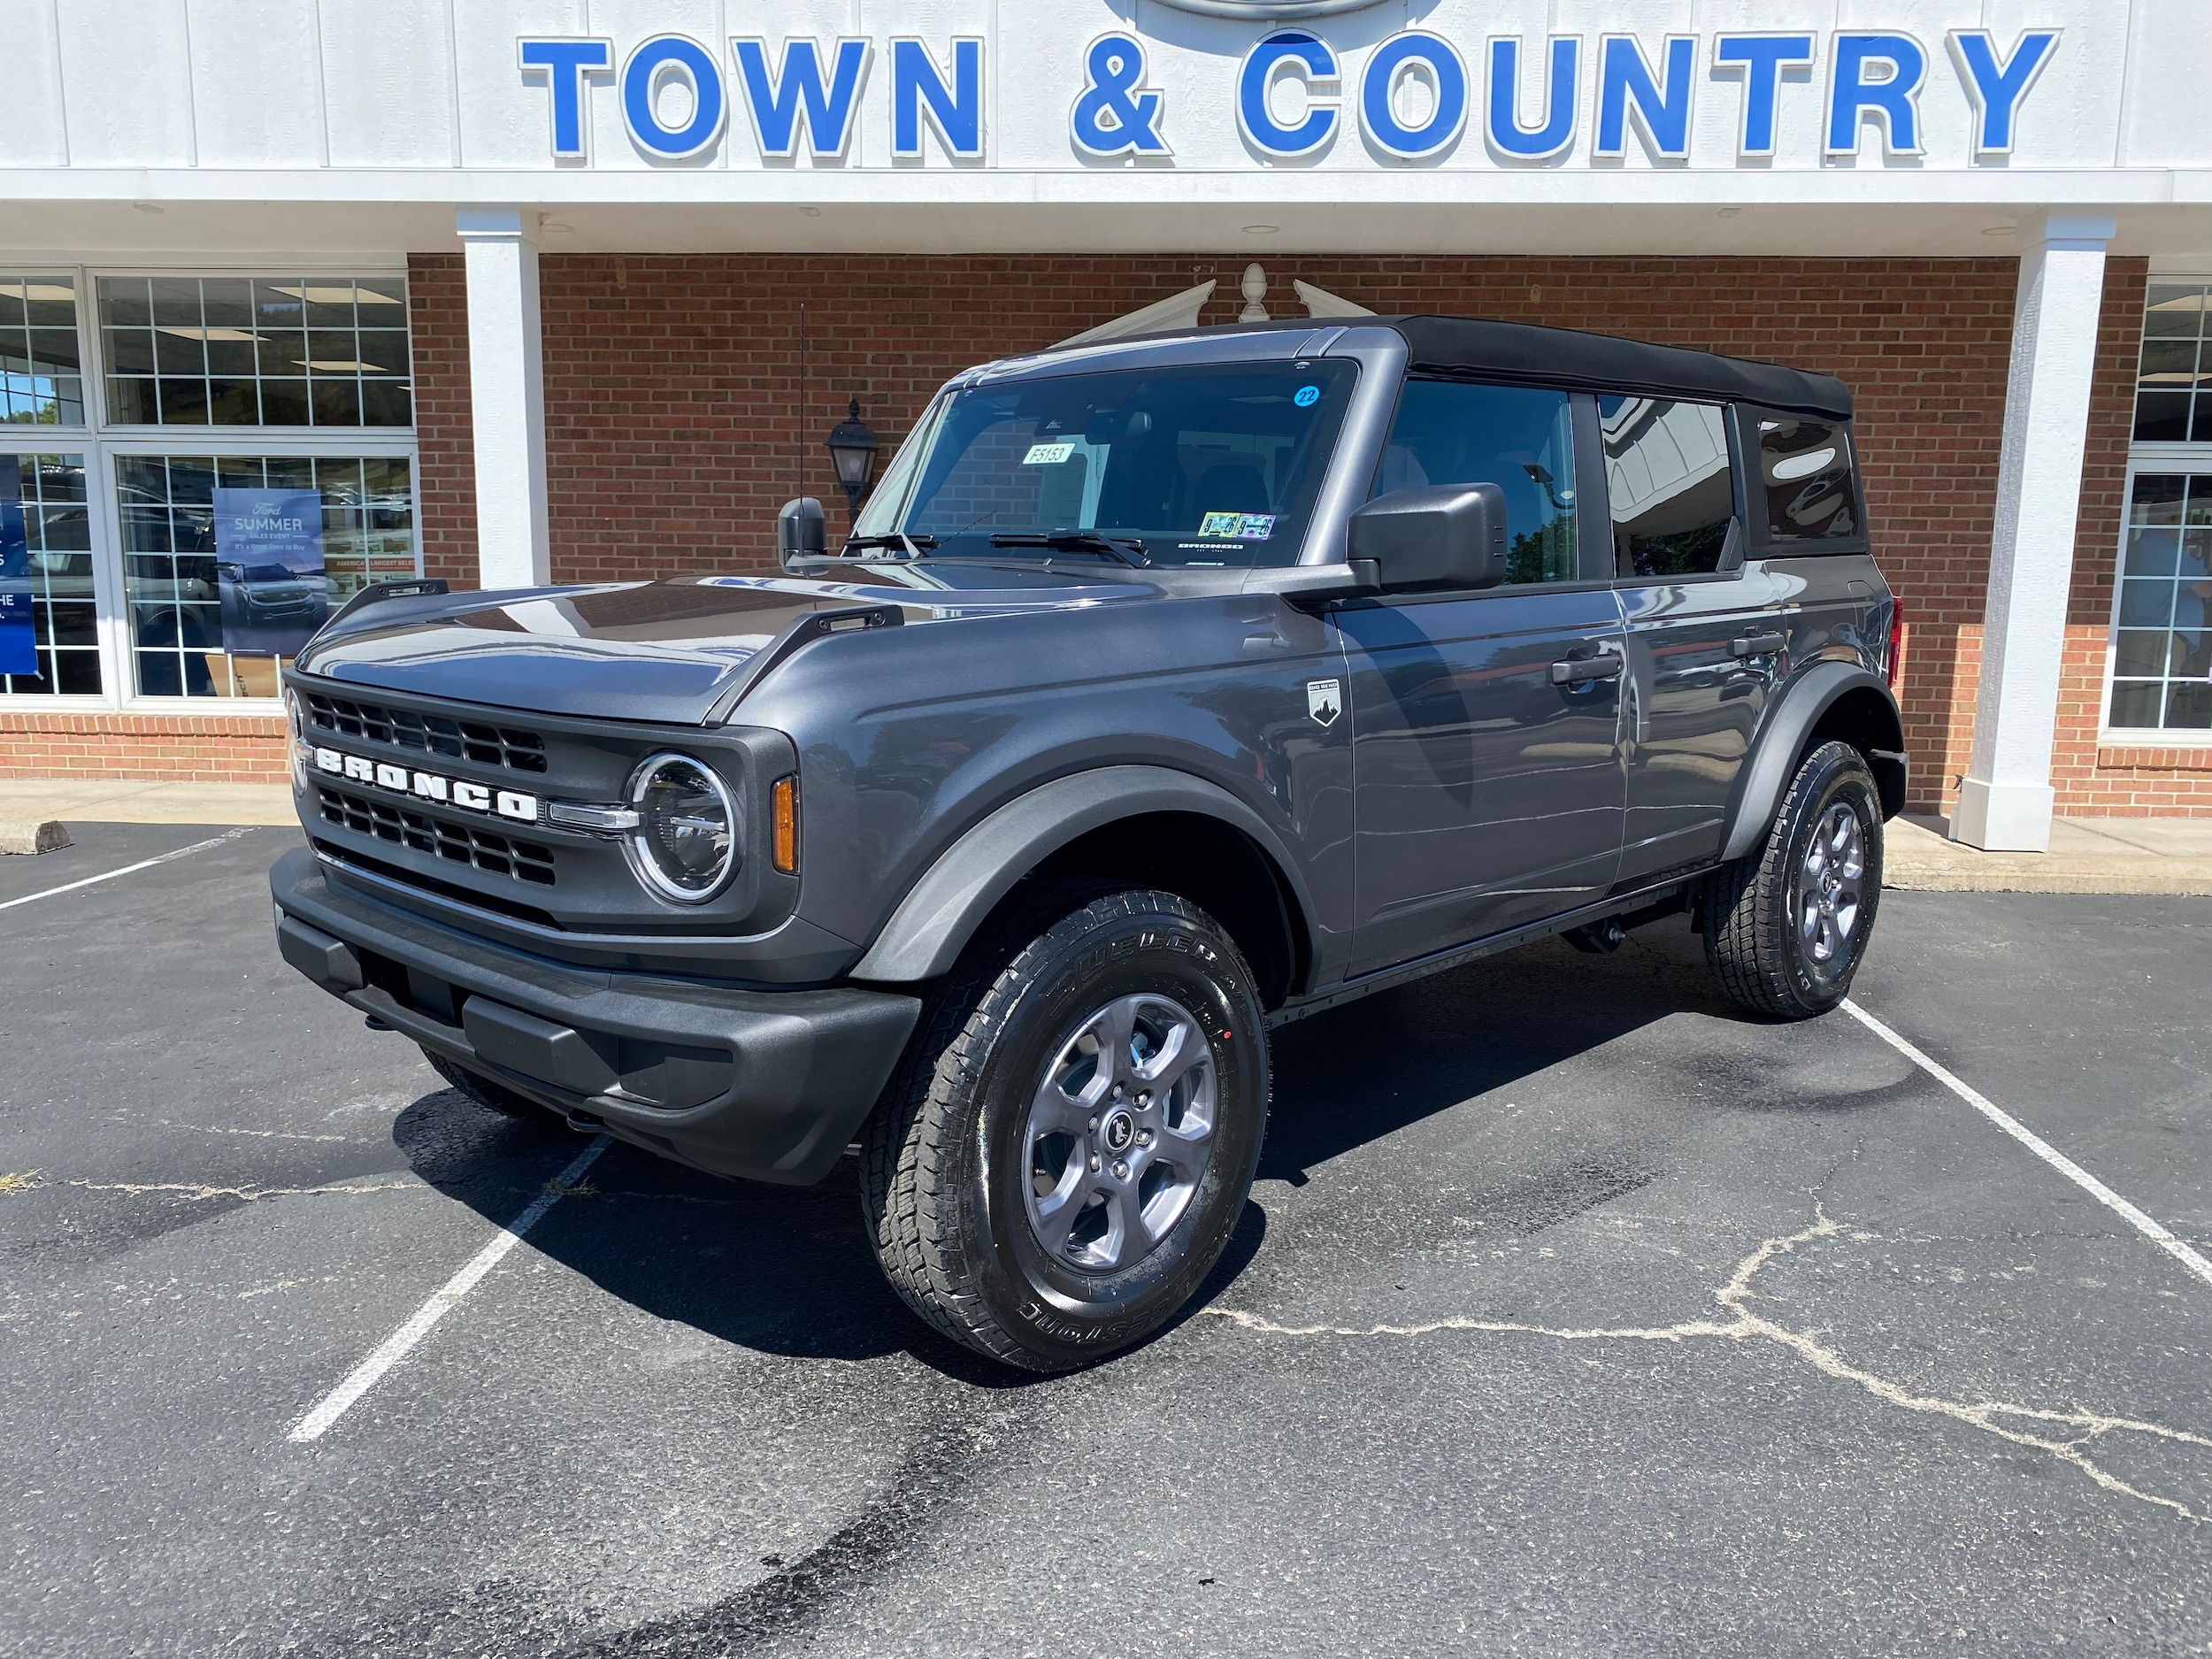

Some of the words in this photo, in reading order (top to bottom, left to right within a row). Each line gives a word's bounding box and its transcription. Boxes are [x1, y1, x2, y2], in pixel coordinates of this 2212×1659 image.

[517, 33, 987, 160] TOWN
[1069, 30, 1175, 157] &
[1236, 27, 2066, 160] COUNTRY
[1298, 389, 1316, 403] 22
[1028, 447, 1065, 462] F5153
[252, 502, 282, 516] Ford
[234, 518, 303, 531] SUMMER
[1204, 518, 1213, 533] 9
[1238, 520, 1247, 535] 9
[316, 747, 539, 821] BRONCO
